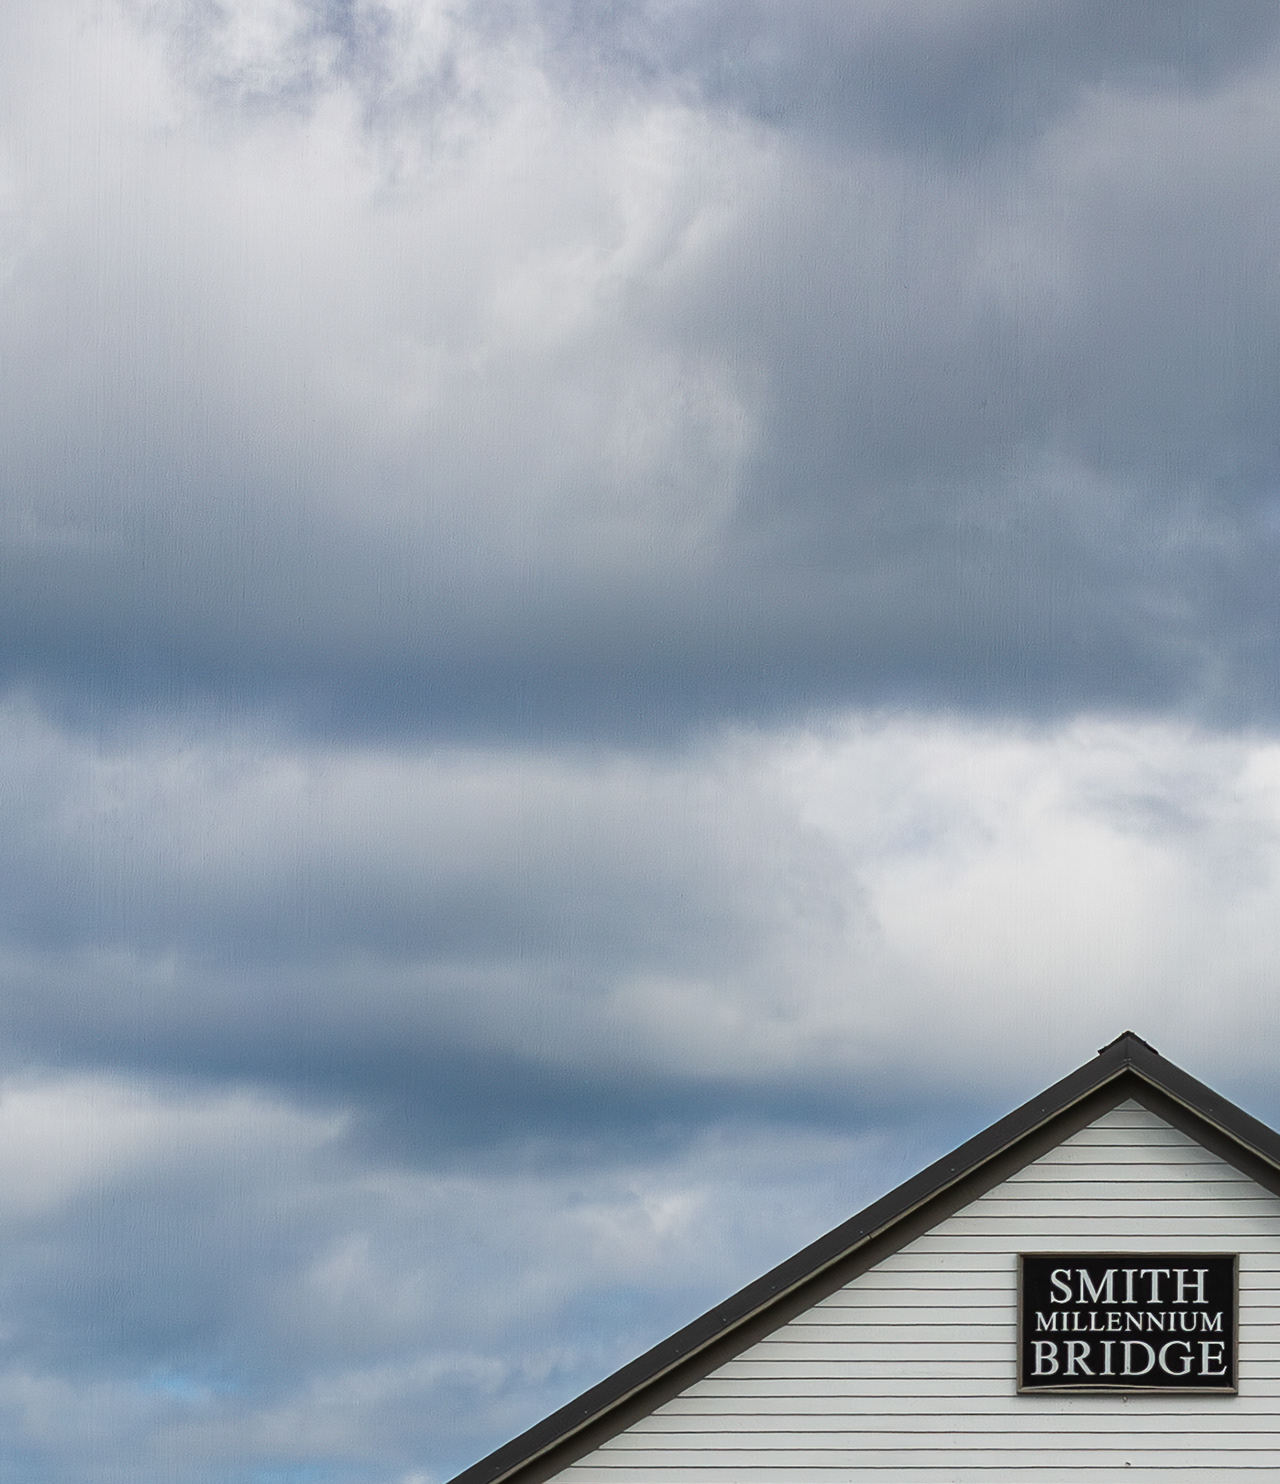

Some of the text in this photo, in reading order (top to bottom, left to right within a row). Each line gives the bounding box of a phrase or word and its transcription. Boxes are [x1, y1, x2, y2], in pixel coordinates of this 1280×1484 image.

[1050, 1268, 1209, 1304] SMITH
[1035, 1311, 1224, 1332] MILLENNIUM
[1030, 1340, 1227, 1376] BRIDGE
